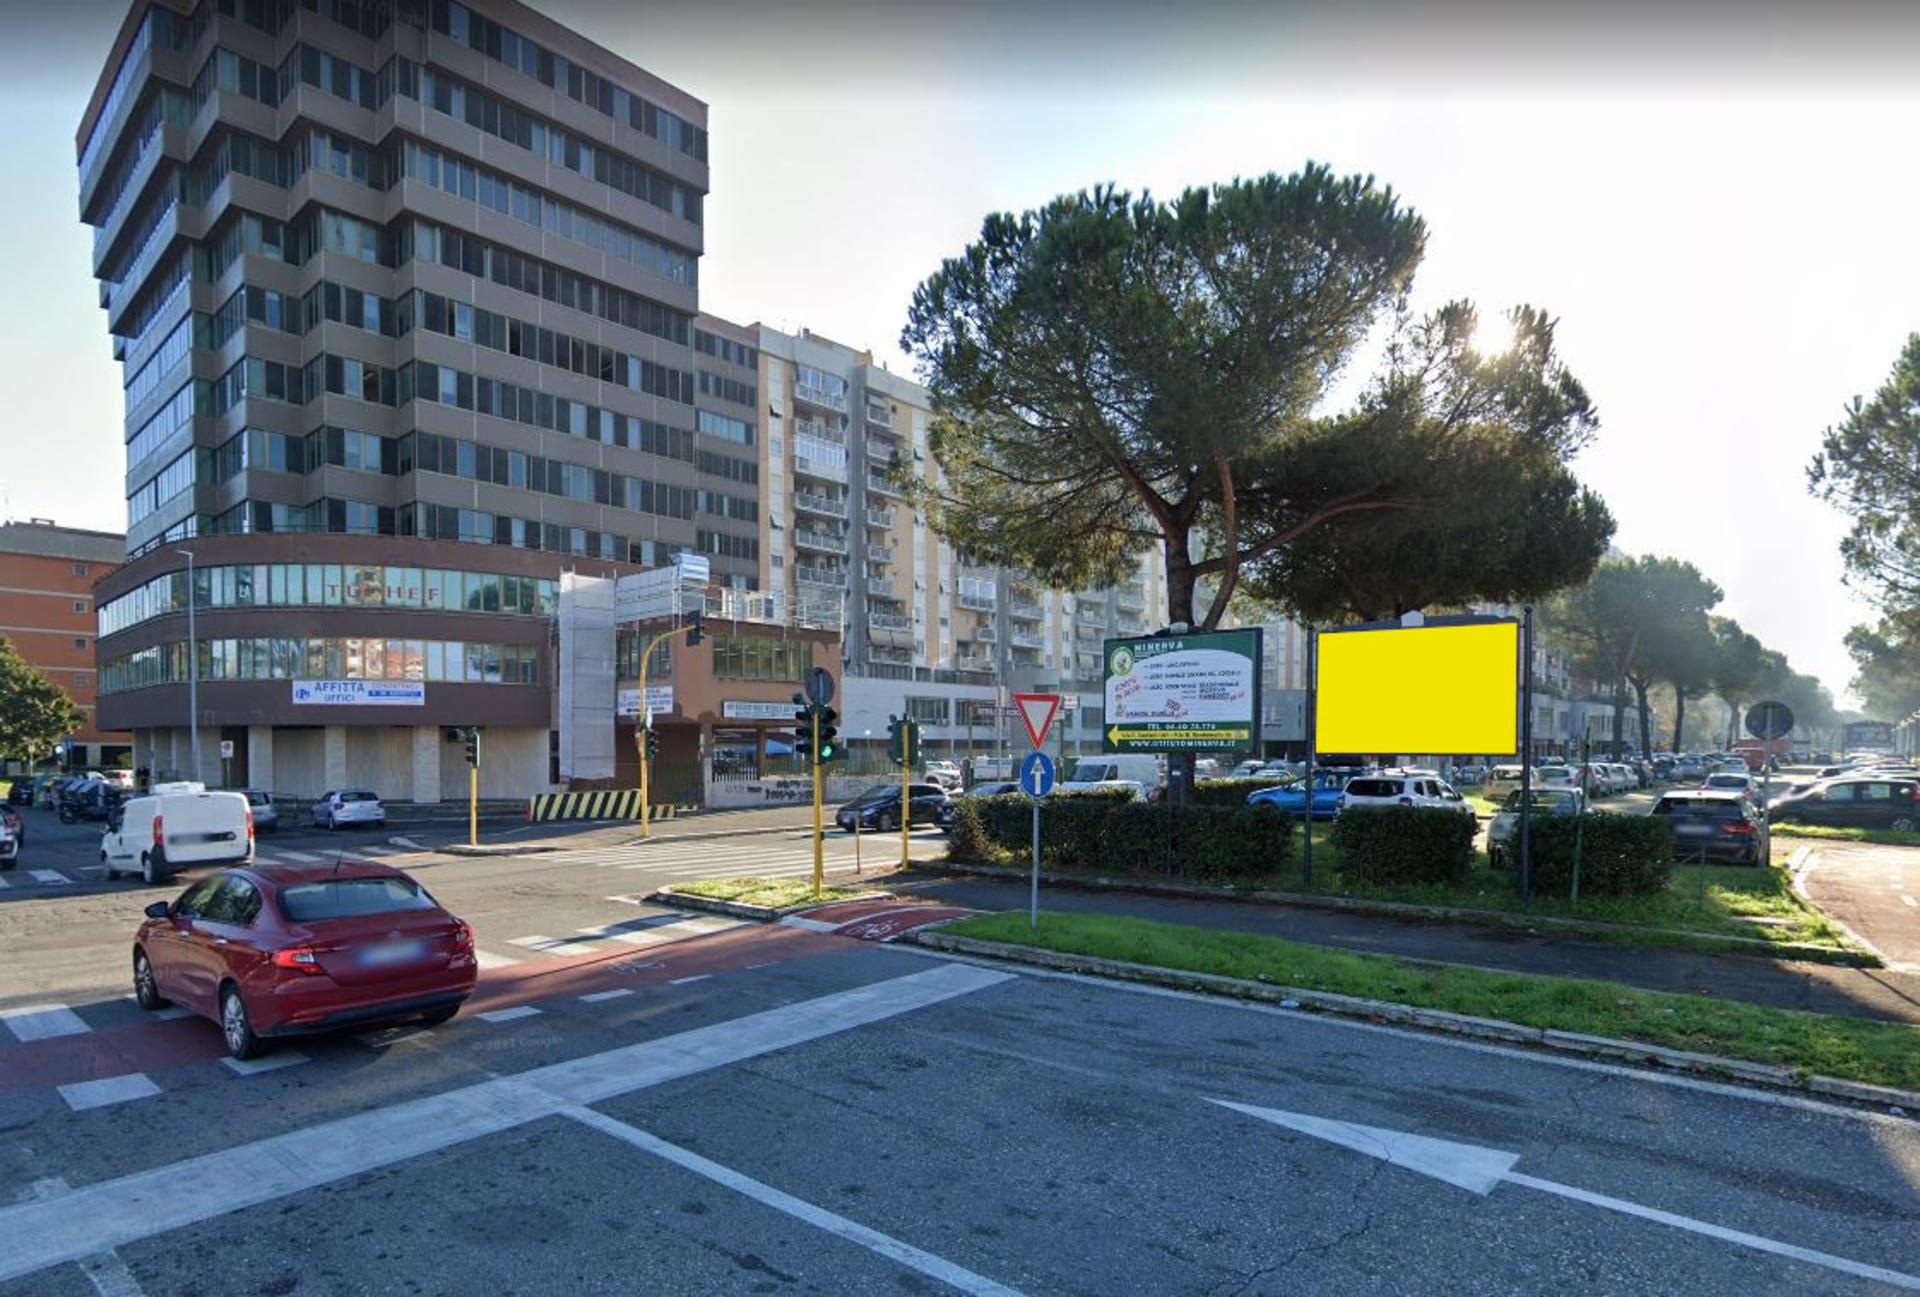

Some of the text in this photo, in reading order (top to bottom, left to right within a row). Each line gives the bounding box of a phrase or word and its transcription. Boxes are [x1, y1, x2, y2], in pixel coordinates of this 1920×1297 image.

[1134, 641, 1184, 651] MINERVA
[314, 682, 365, 694] AFFITTA
[324, 694, 355, 702] UFFICI
